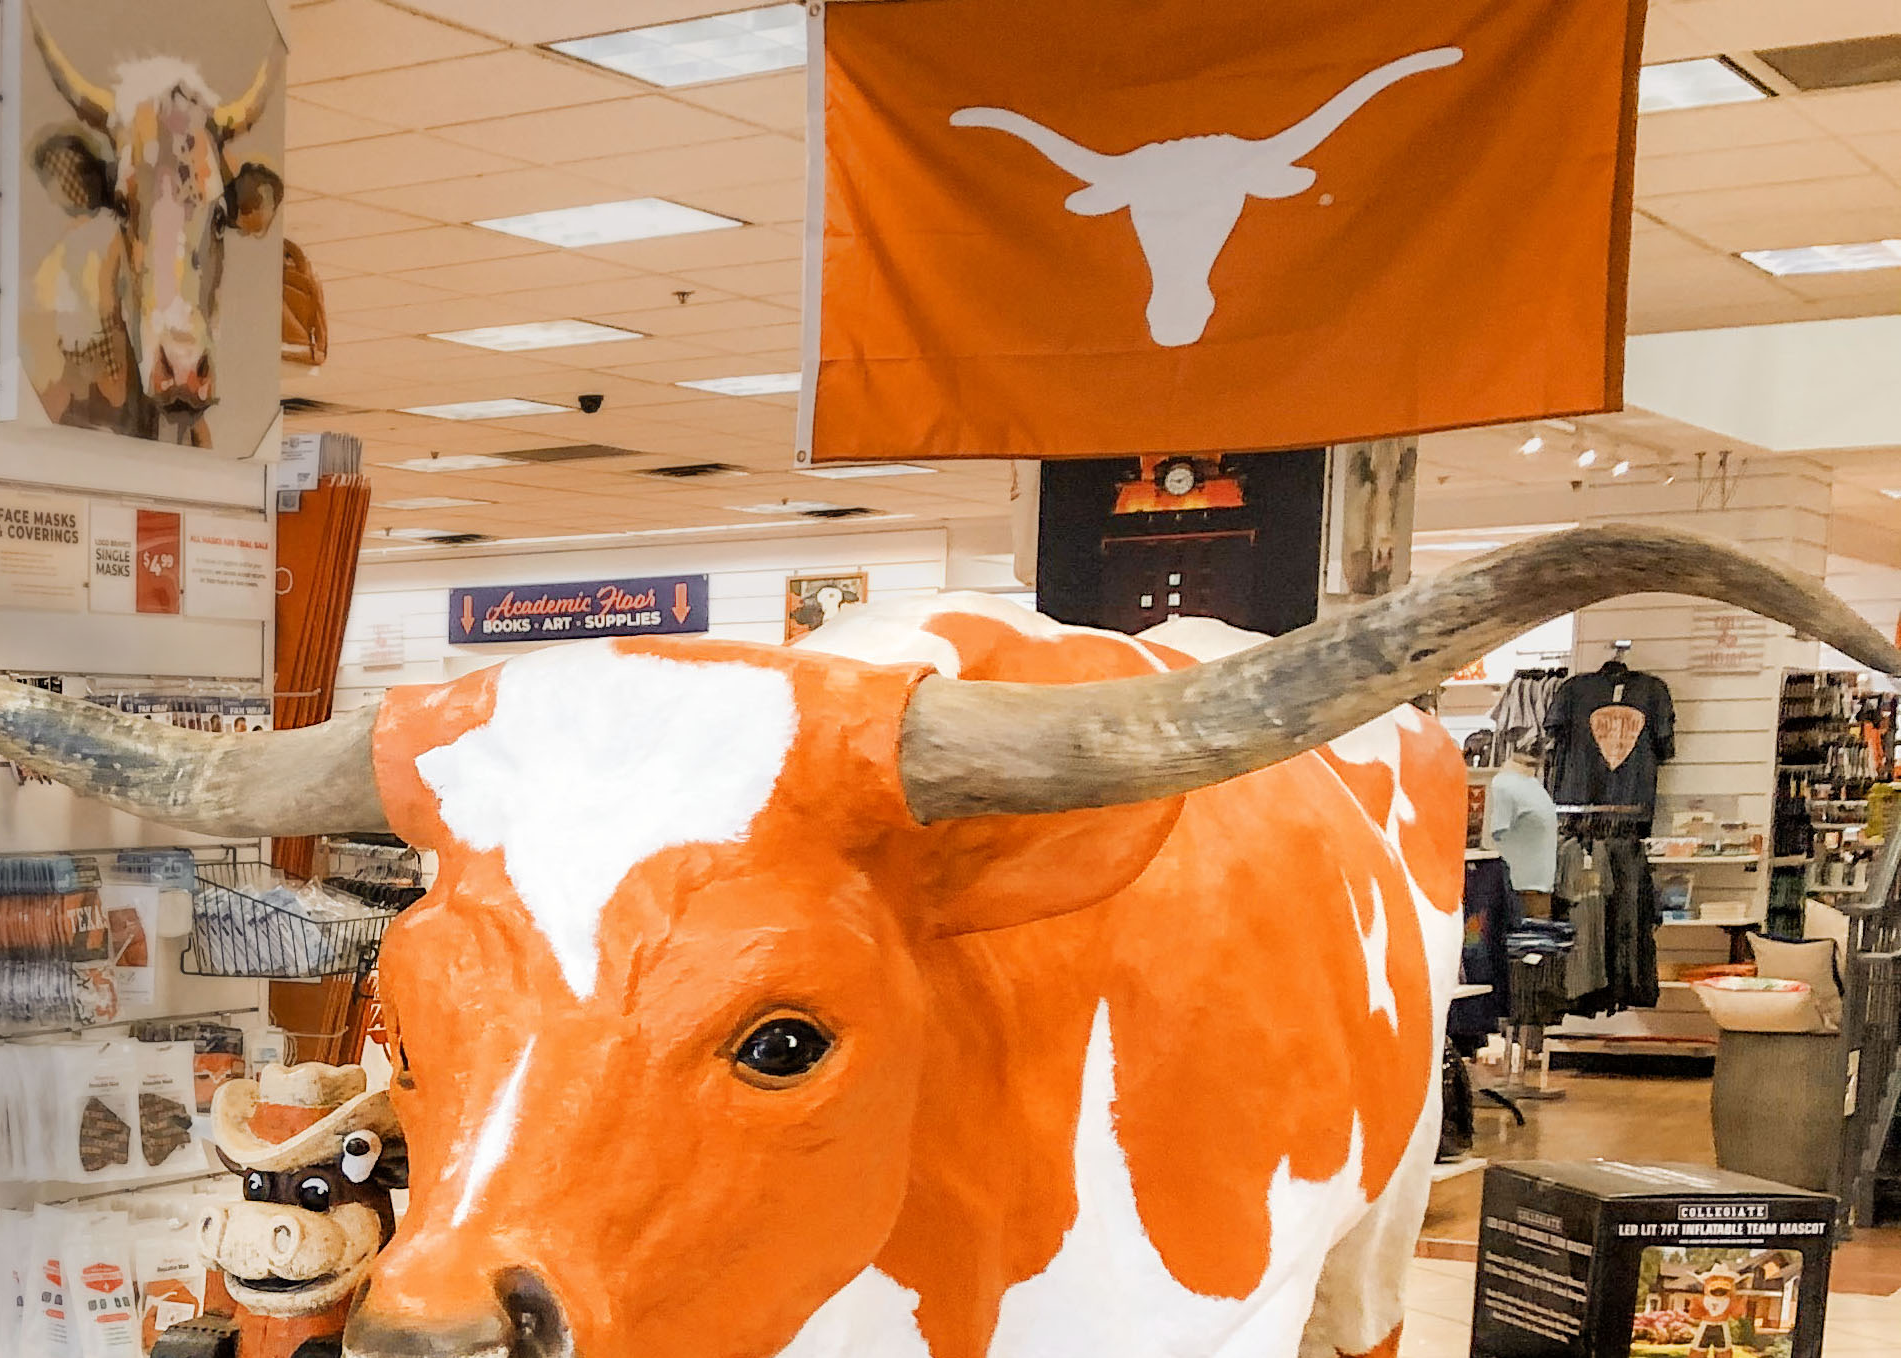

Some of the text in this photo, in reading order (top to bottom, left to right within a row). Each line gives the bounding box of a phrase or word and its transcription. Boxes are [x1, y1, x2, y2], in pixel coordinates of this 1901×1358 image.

[34, 511, 76, 528] MASKS
[8, 525, 79, 544] COVERINGS
[96, 548, 130, 562] SINGLE
[96, 562, 130, 577] MASKS
[486, 585, 656, 621] Academic Floor
[483, 611, 661, 633] BOOKS ART SUPPLIES
[1681, 1206, 1765, 1217] COLLEGIATE
[1618, 1222, 1826, 1236] LED LIT 7FT INFLATABLE TEAM MASCOT
